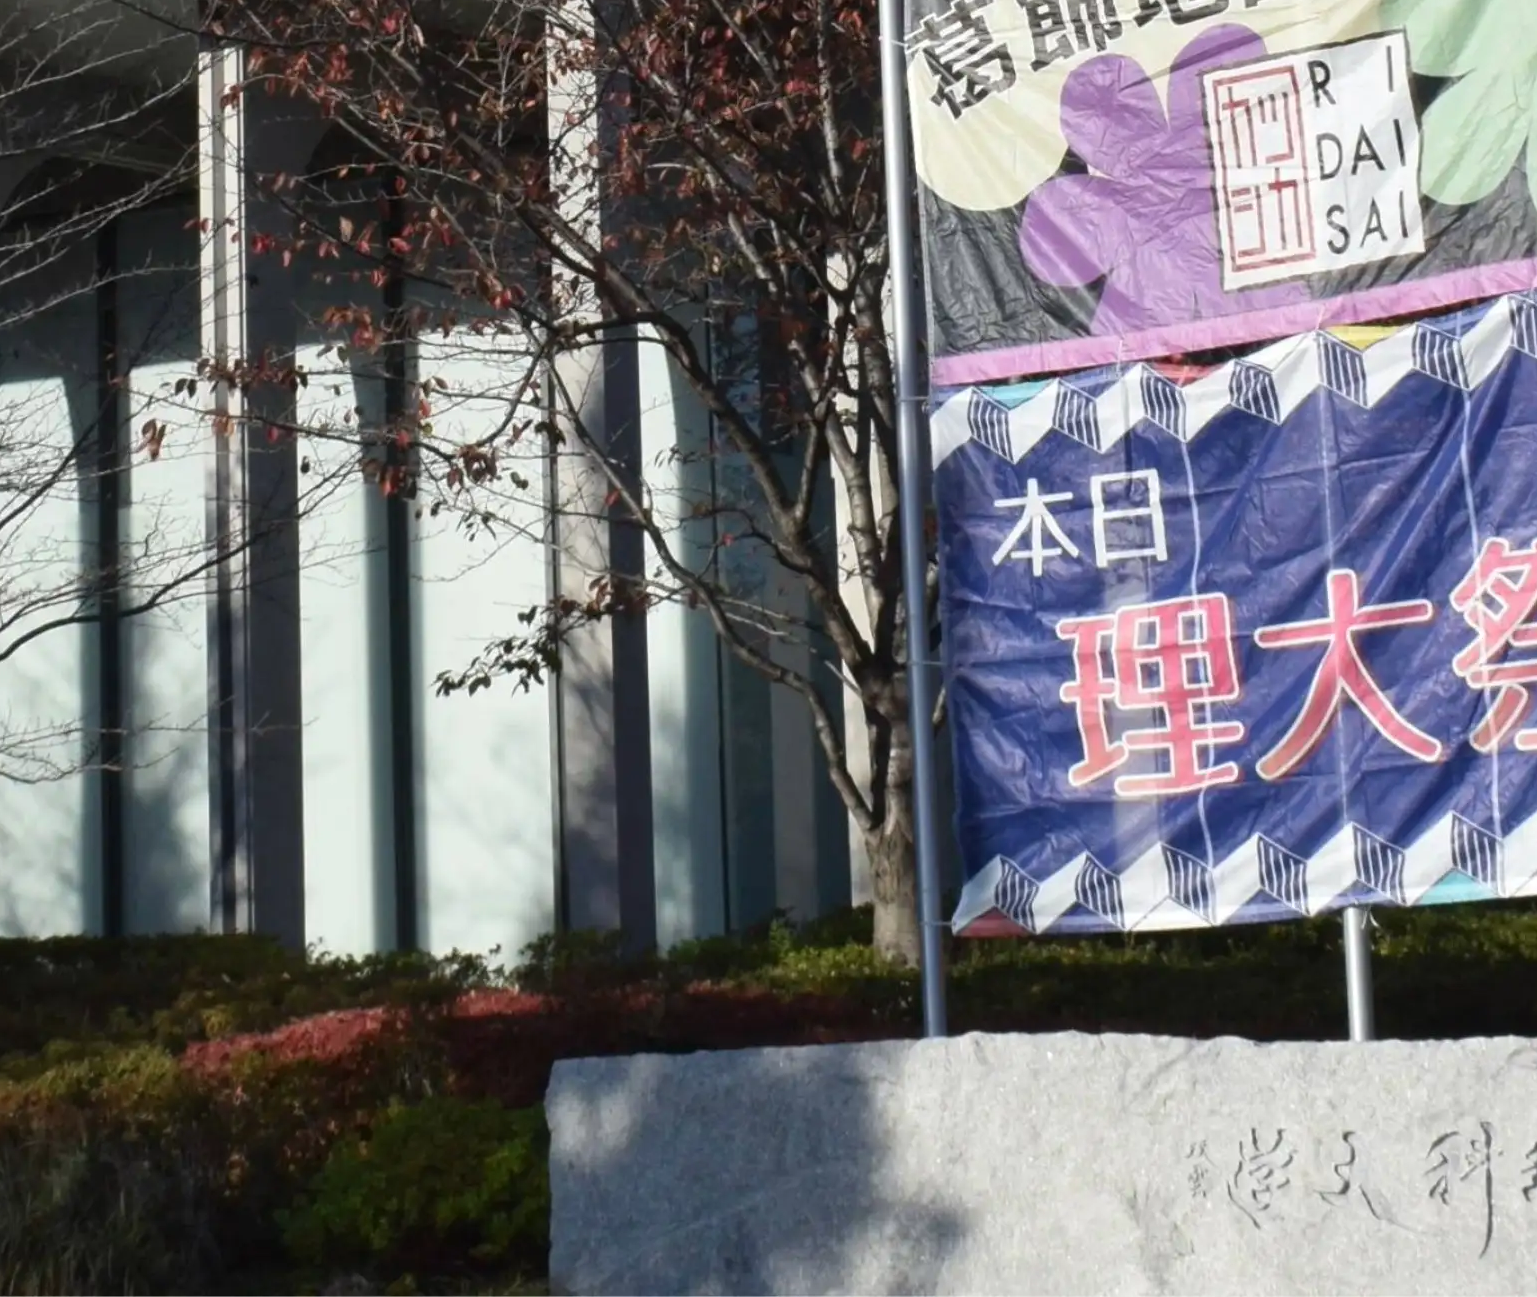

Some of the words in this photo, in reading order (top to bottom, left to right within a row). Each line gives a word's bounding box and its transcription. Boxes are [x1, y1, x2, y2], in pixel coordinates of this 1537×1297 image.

[1315, 118, 1407, 181] DAI
[1325, 190, 1409, 255] SAI
[992, 468, 1169, 578] 本日
